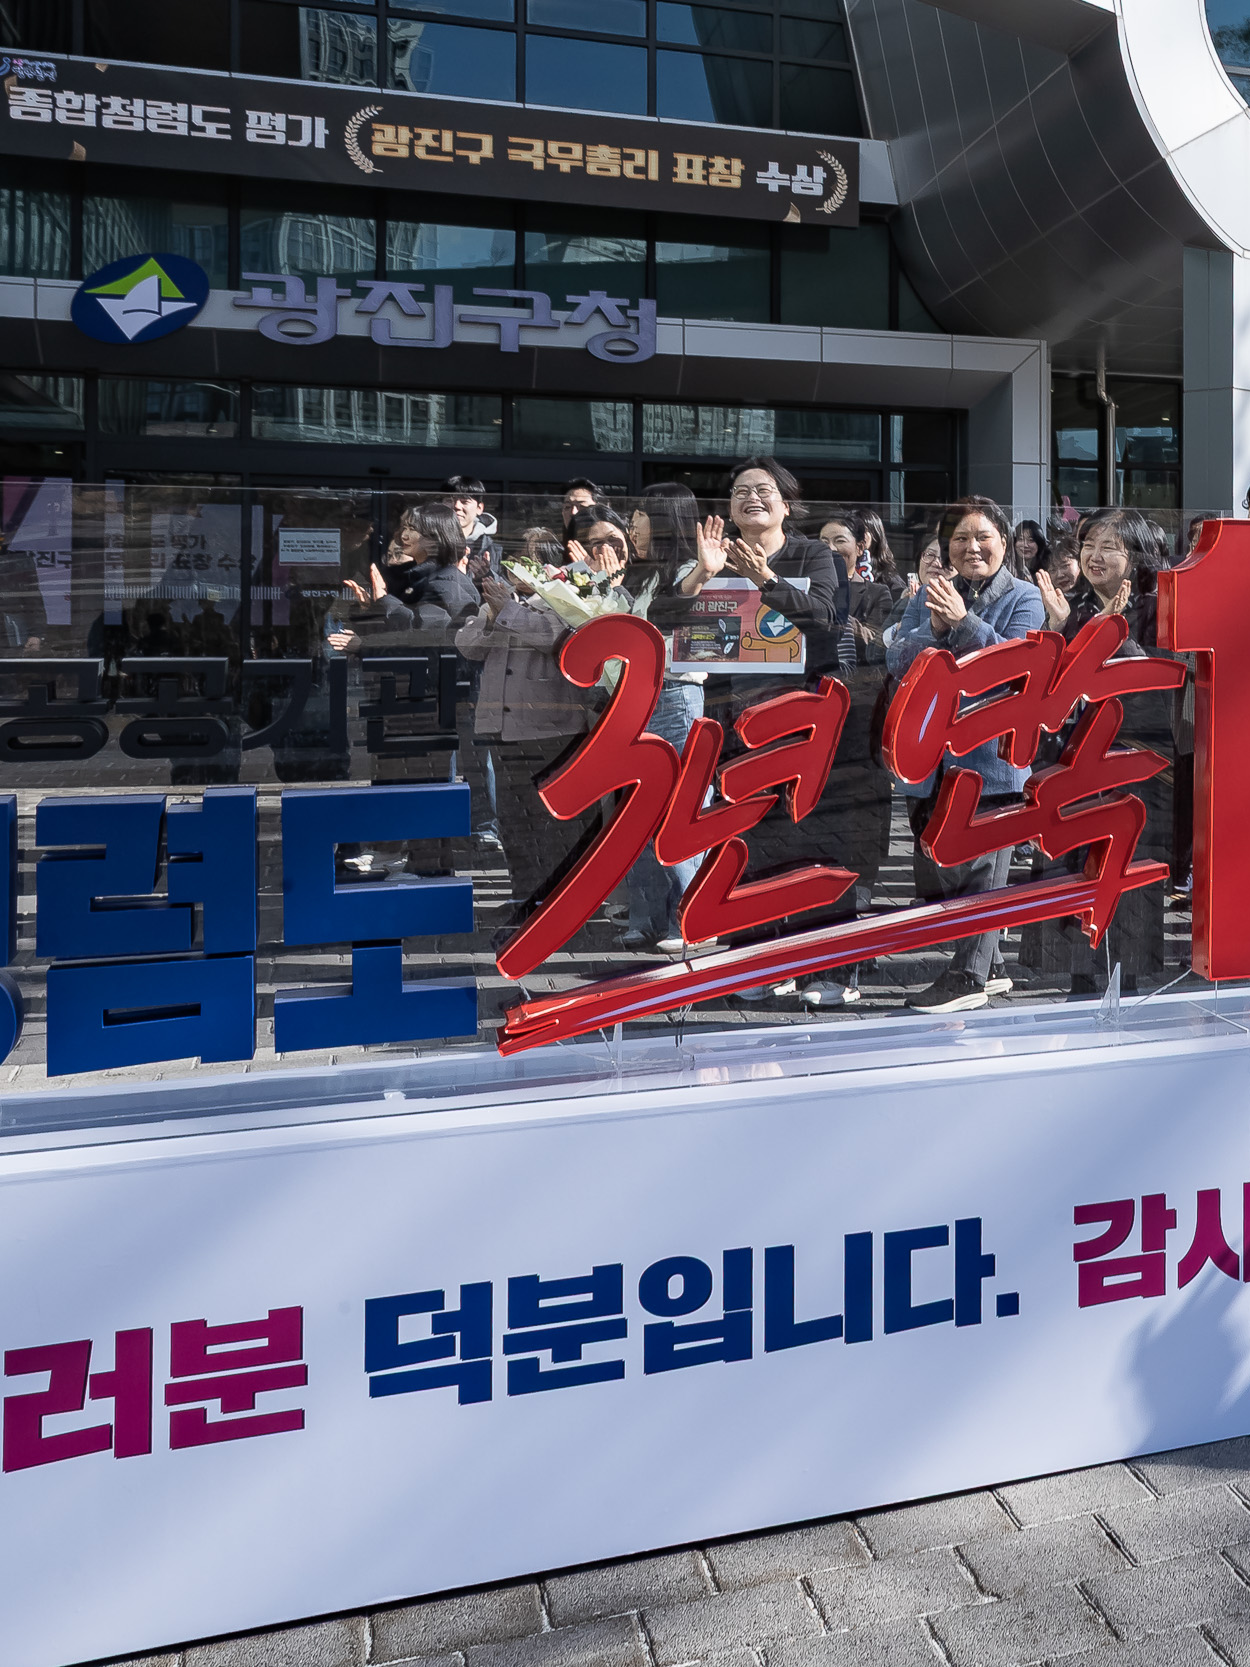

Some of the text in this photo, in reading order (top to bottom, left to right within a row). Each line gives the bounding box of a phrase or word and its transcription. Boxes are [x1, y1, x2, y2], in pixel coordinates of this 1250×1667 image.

[8, 86, 826, 197] 종합청렴도 평가 광진구 국무총리 표창 수상
[233, 272, 657, 363] 광진구청
[708, 601, 738, 613] 광진구
[0, 655, 470, 762] 공공기관
[0, 782, 478, 1077] 렴도
[496, 613, 860, 980] 3년
[3, 1305, 308, 1473] 러분
[364, 1217, 1020, 1405] 덕분입니다.
